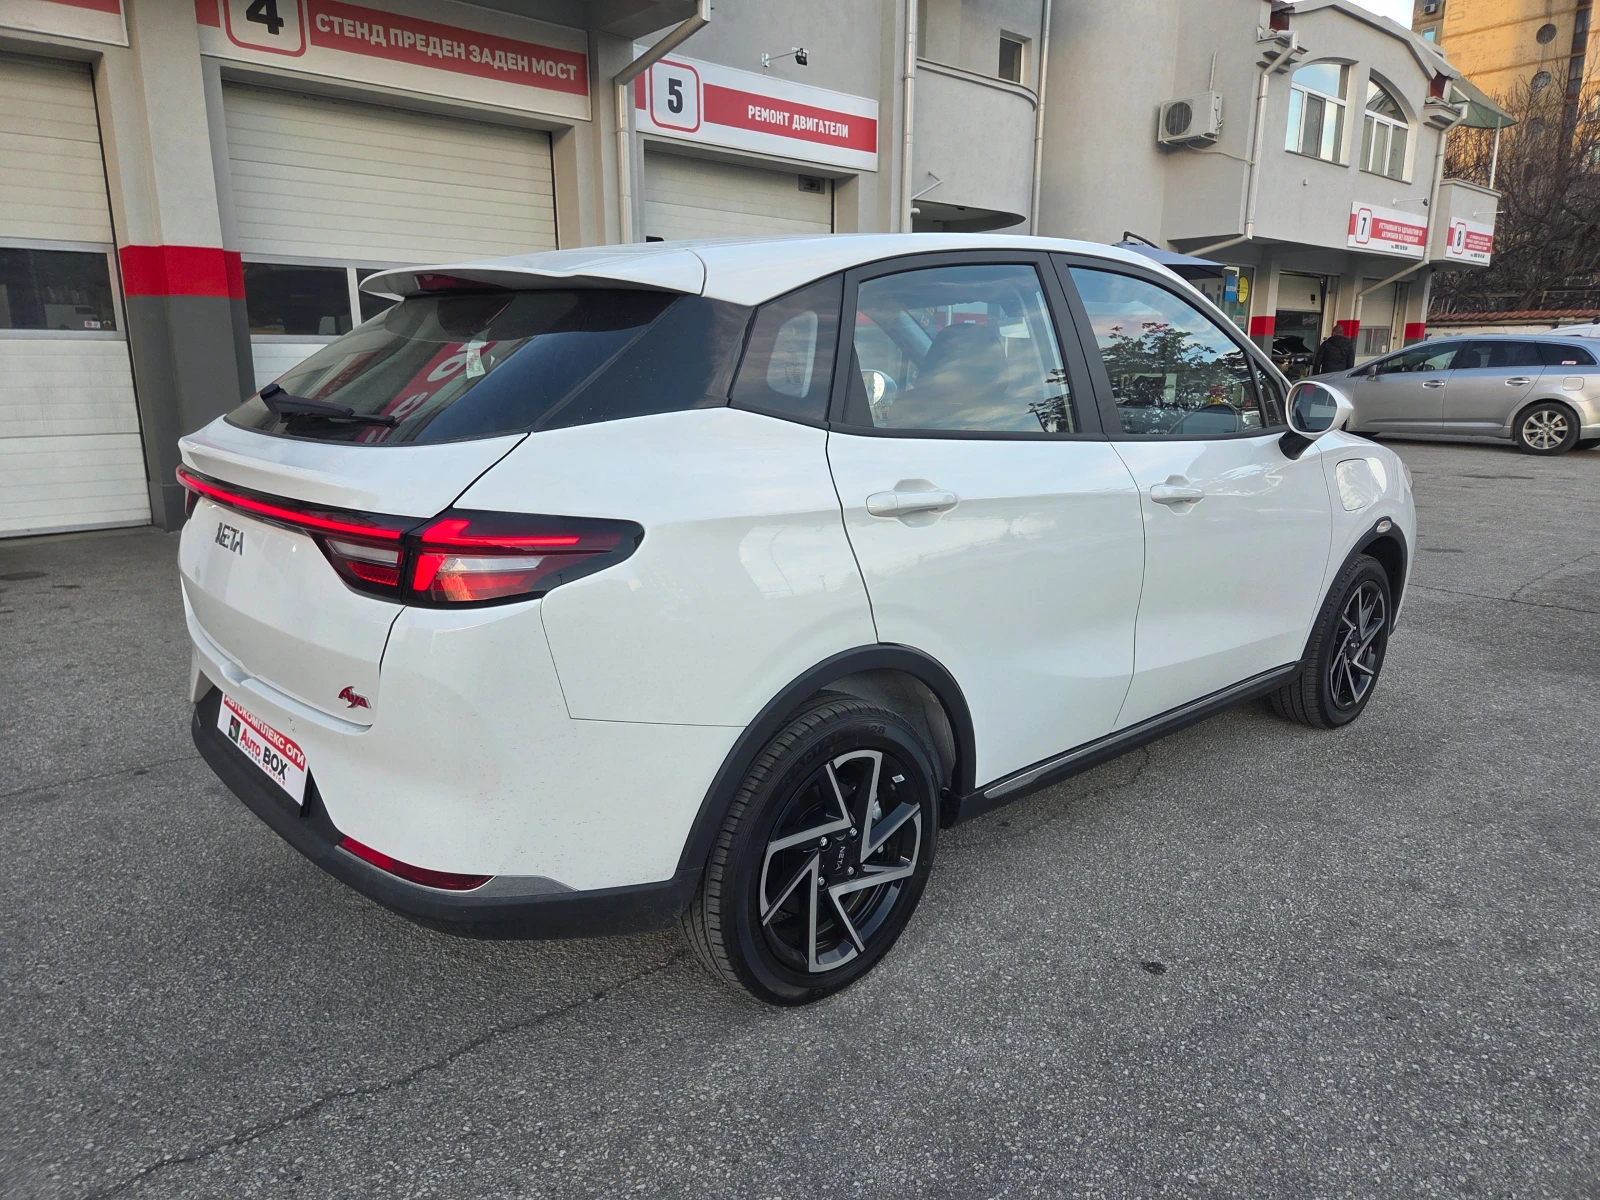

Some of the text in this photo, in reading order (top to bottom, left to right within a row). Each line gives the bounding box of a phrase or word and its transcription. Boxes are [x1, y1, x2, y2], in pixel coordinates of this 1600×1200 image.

[246, 0, 284, 35] 4
[316, 13, 577, 81] СТЕНД ПРЕДЕН ЗАДЕН МОСТ
[667, 78, 683, 114] 5
[748, 104, 849, 138] РЕМОНТ ДВИГАТЕЛИ
[1361, 216, 1367, 236] 7
[1456, 230, 1462, 247] 8
[263, 746, 288, 780] BOX
[286, 744, 306, 767] ОГИ
